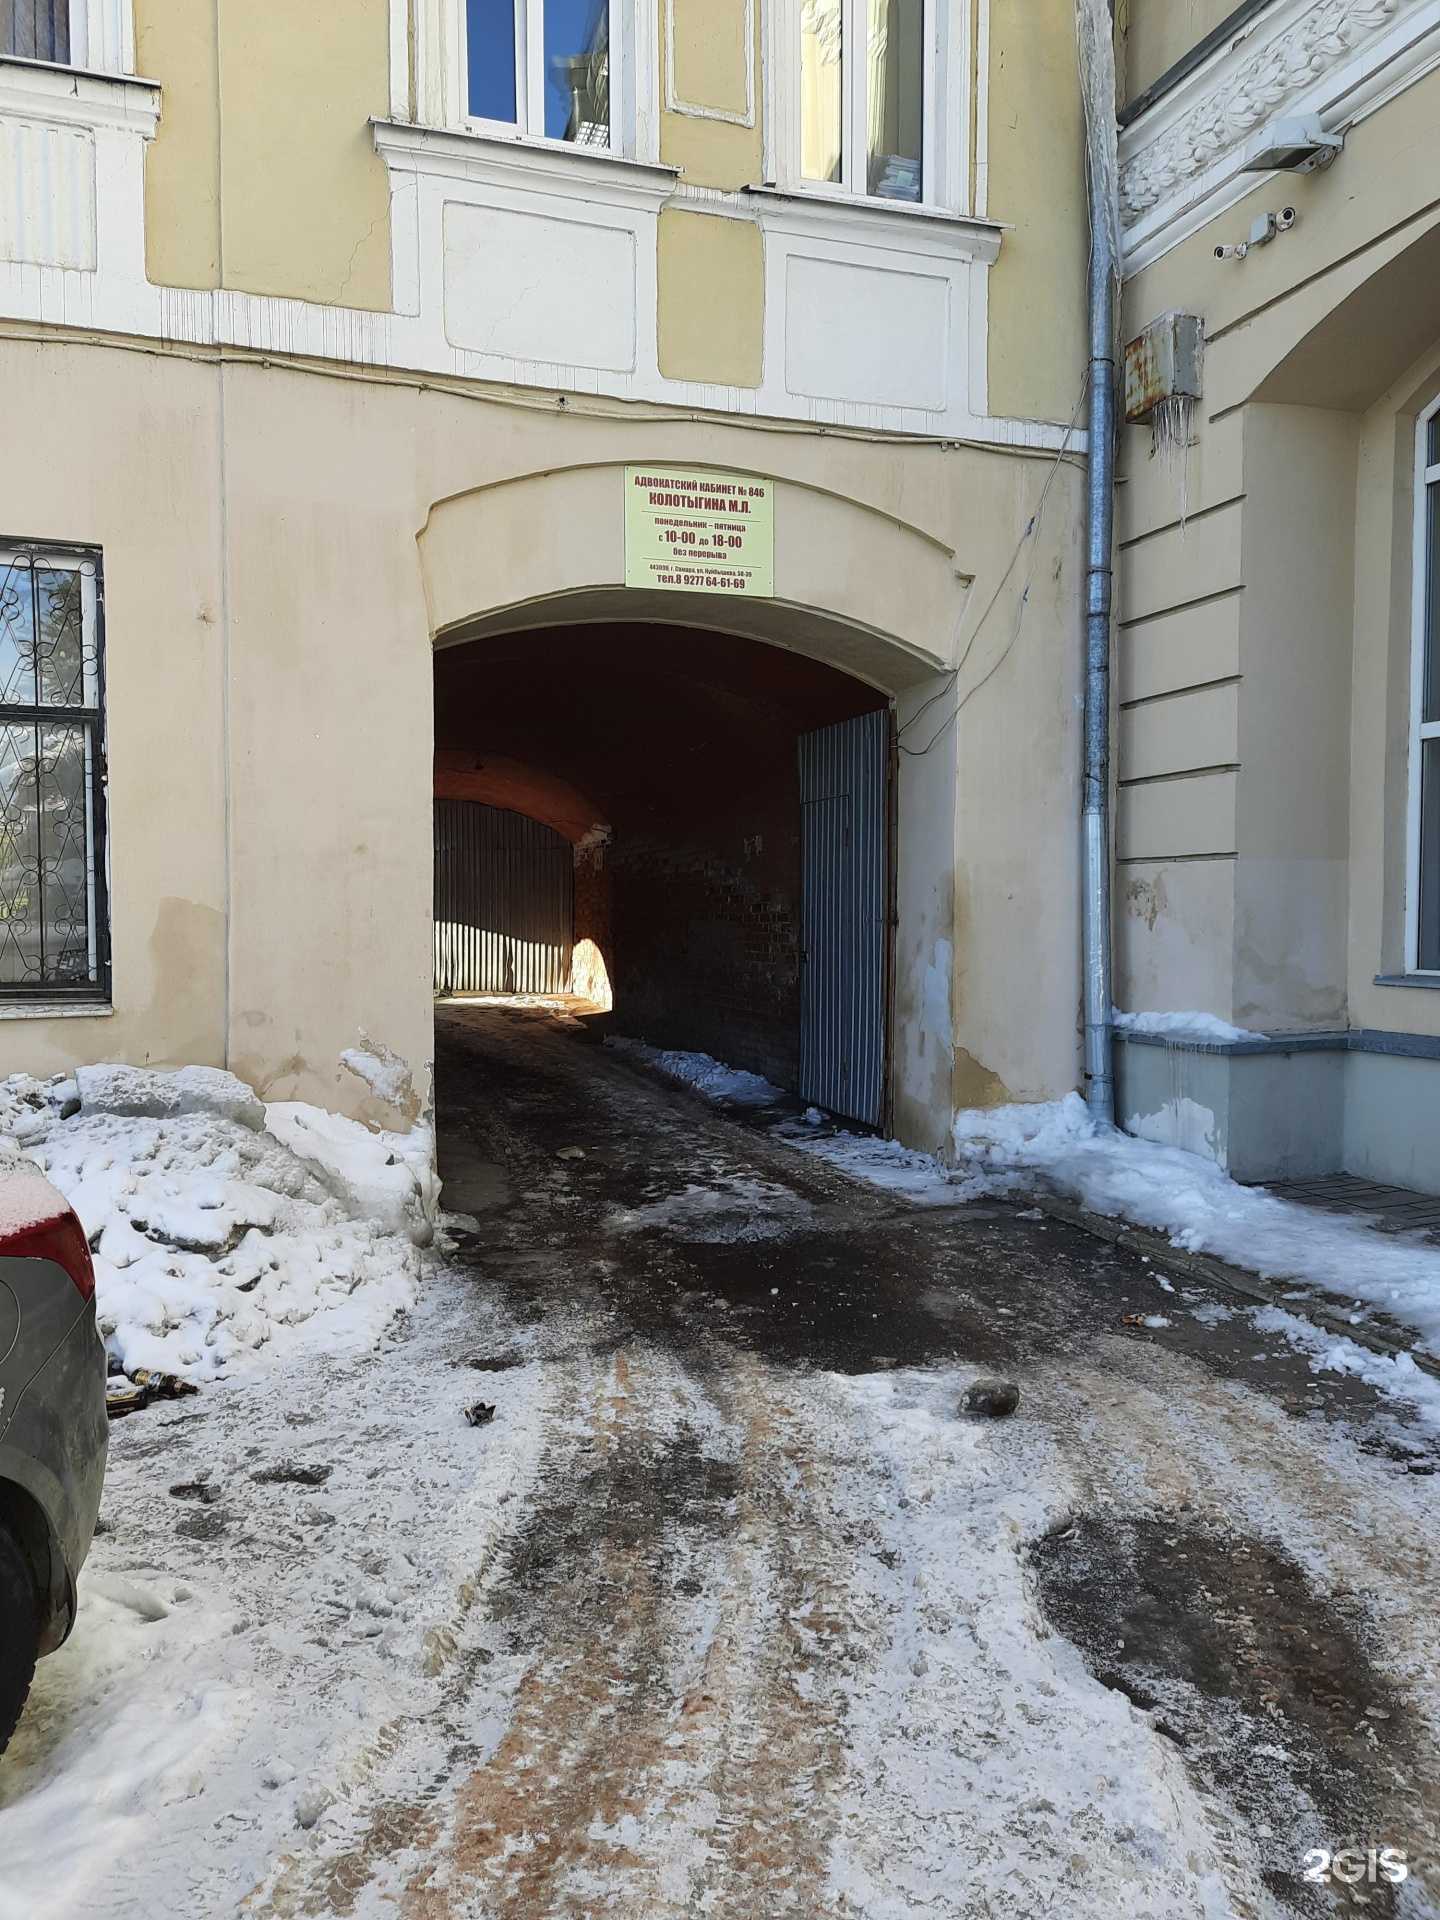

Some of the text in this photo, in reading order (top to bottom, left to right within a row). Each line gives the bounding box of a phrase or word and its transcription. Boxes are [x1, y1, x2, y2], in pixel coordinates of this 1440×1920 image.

[634, 475, 765, 498] АДВОКАТСКИЙ КАБИНЕТ № 846
[649, 492, 752, 514] КОЛОТЫГИНА М.Л.
[654, 517, 708, 529] понедельник
[714, 522, 746, 532] пятница
[658, 530, 743, 549] с 10-00 до 18-00
[673, 547, 727, 560] без перерыва
[683, 575, 705, 586] 9277
[705, 577, 746, 589] 64-61-69
